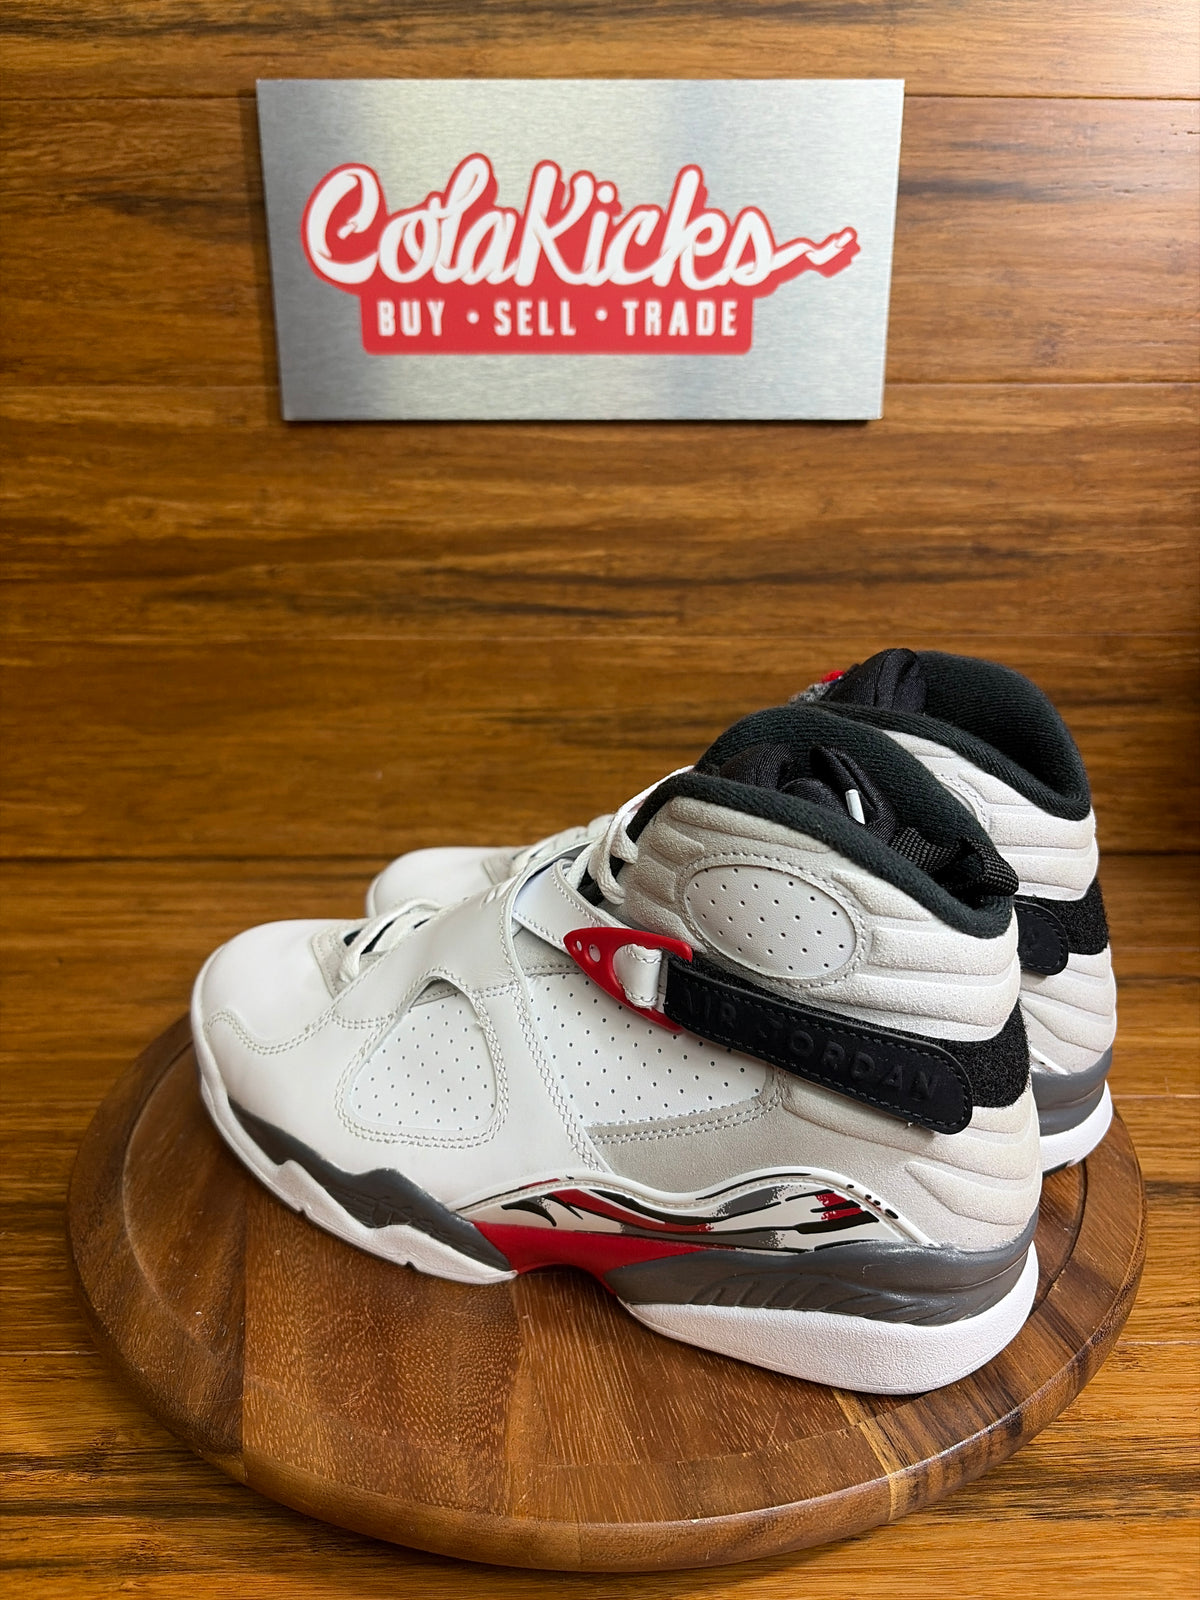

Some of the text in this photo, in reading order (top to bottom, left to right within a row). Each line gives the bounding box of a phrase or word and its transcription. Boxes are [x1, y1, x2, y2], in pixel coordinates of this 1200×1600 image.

[306, 155, 858, 289] ColaKicks
[377, 300, 738, 337] BUY SELL TRADE
